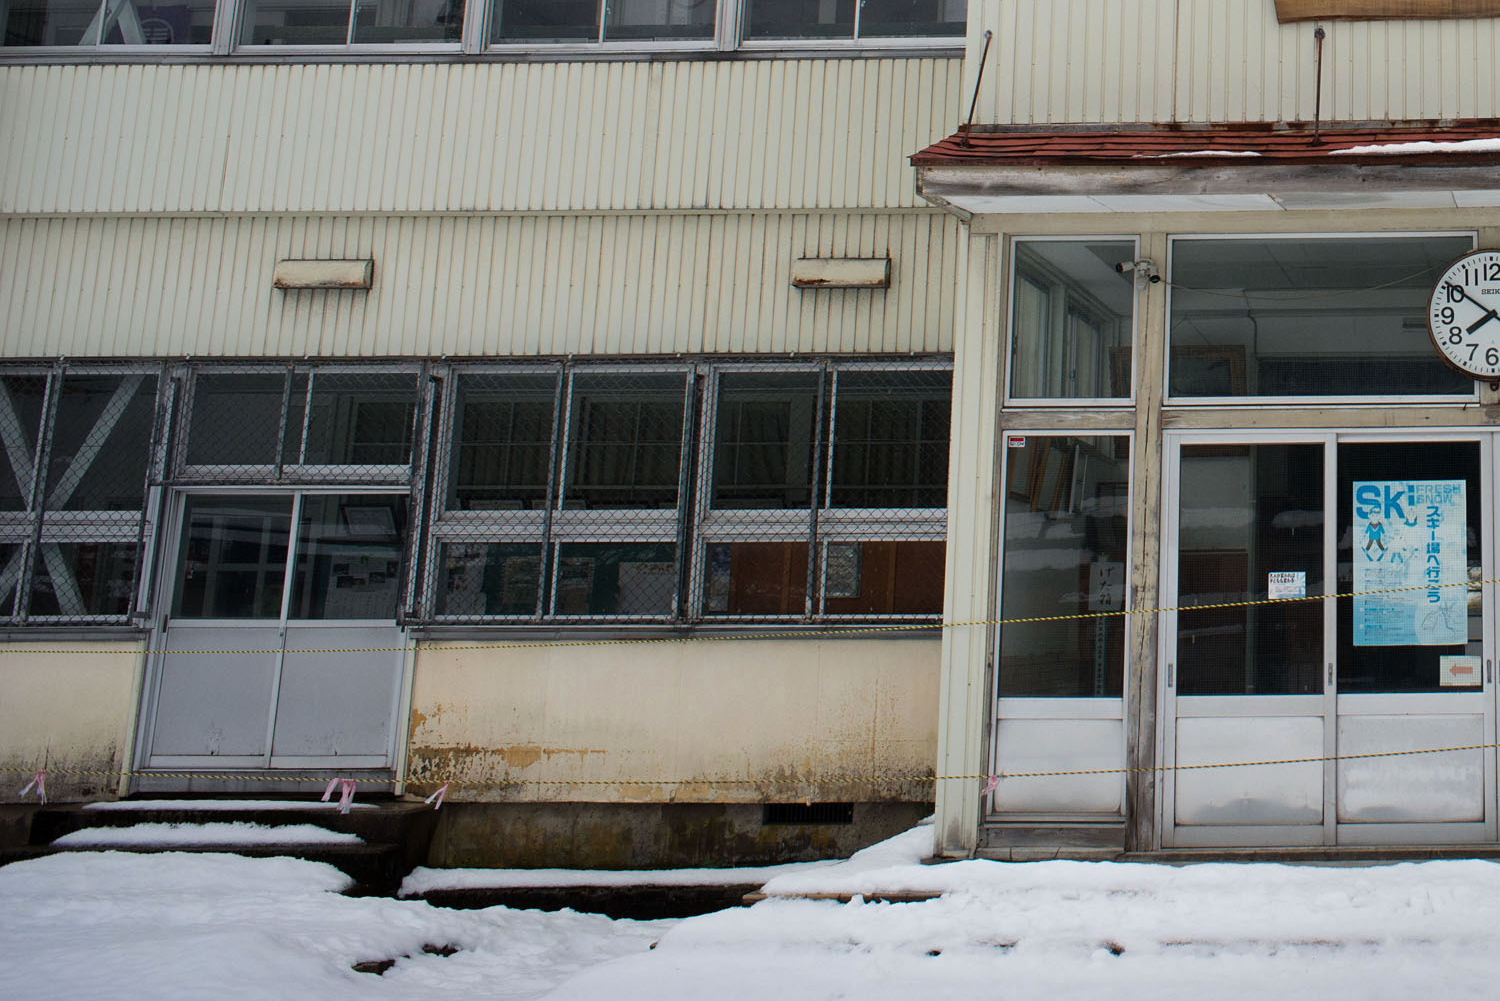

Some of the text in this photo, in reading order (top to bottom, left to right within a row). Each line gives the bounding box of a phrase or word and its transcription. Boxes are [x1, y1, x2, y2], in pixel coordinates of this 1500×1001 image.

[1465, 268, 1479, 286] 11
[1446, 284, 1465, 303] 10
[1441, 306, 1455, 325] 9
[1449, 326, 1462, 345] 8
[1465, 343, 1479, 361] 7
[1485, 347, 1499, 366] 6
[1416, 484, 1462, 494] FRESH
[1426, 505, 1441, 604] スキー場へ行こう
